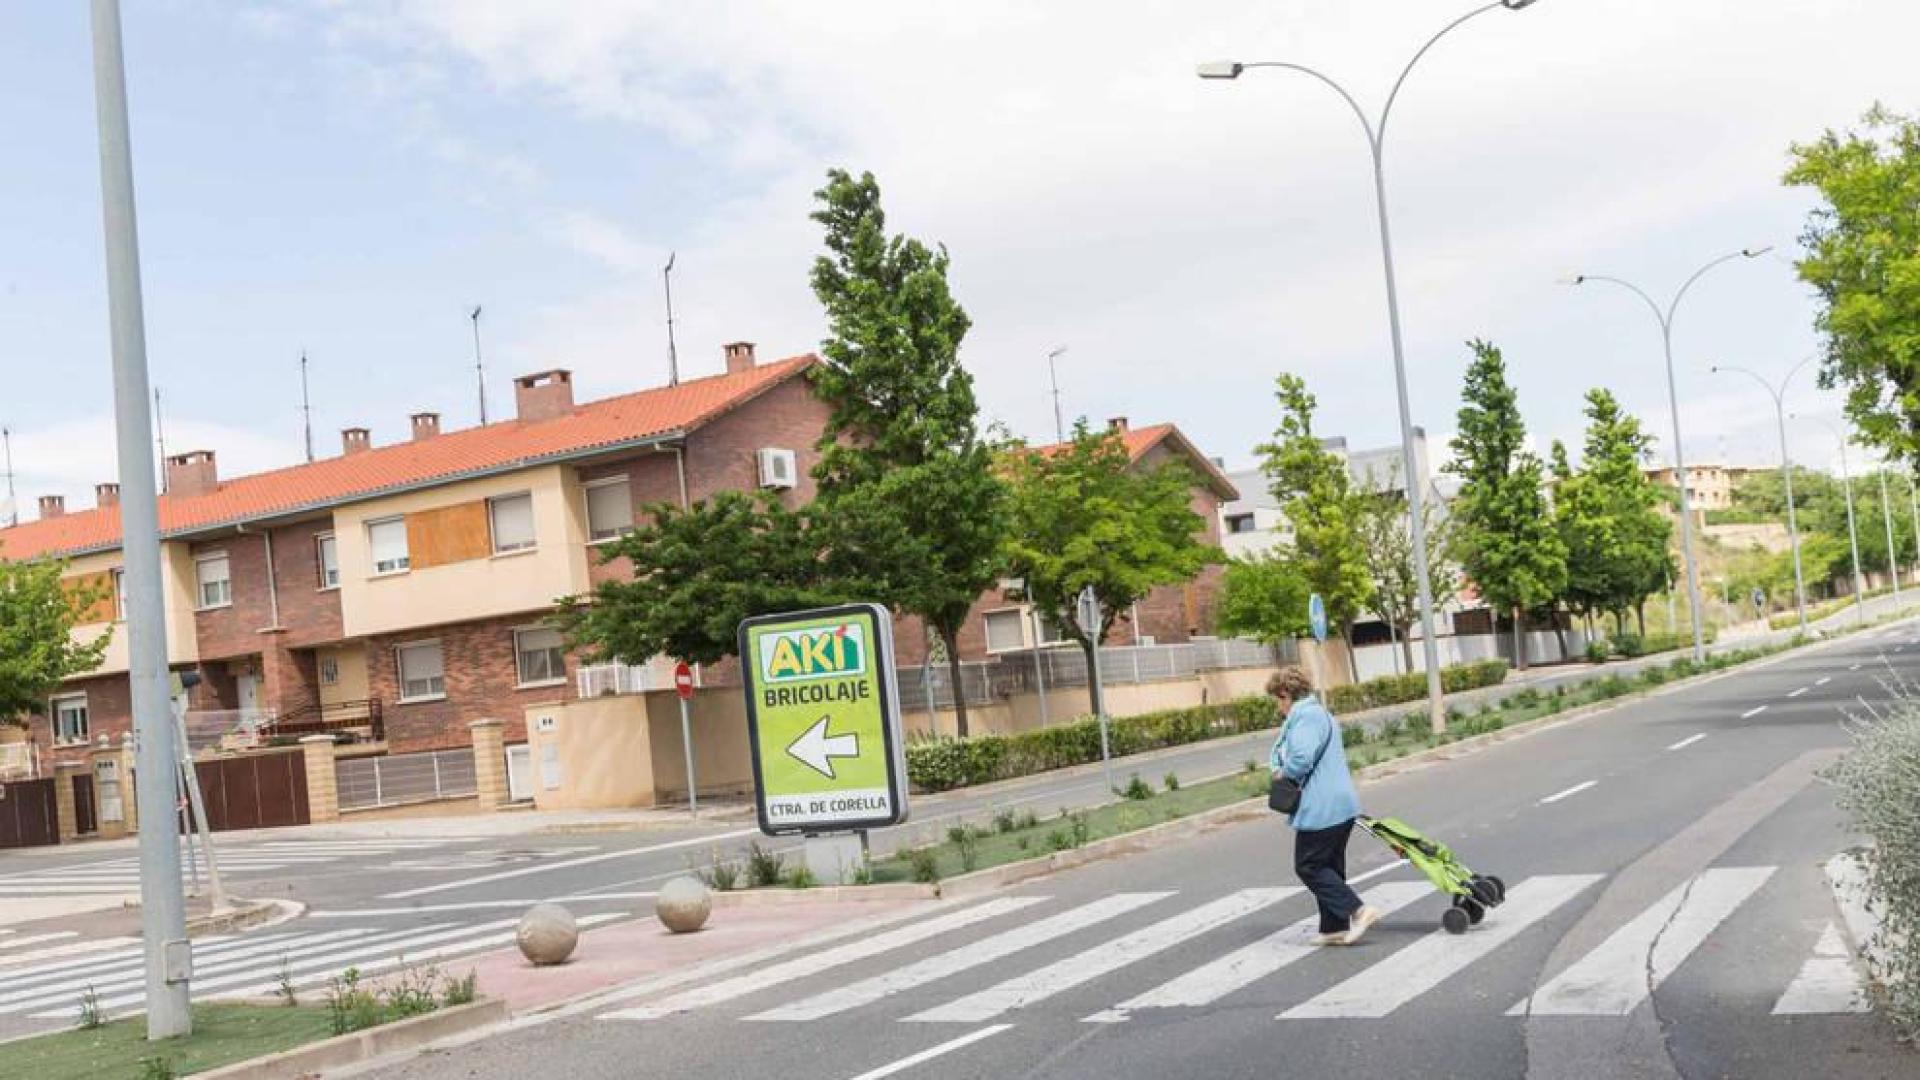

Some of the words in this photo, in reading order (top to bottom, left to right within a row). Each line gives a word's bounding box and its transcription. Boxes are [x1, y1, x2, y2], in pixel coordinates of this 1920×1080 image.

[765, 680, 870, 707] BRICOLAJE
[769, 802, 805, 817] CTRA.
[810, 800, 827, 814] DE
[830, 796, 887, 811] CORELLA
